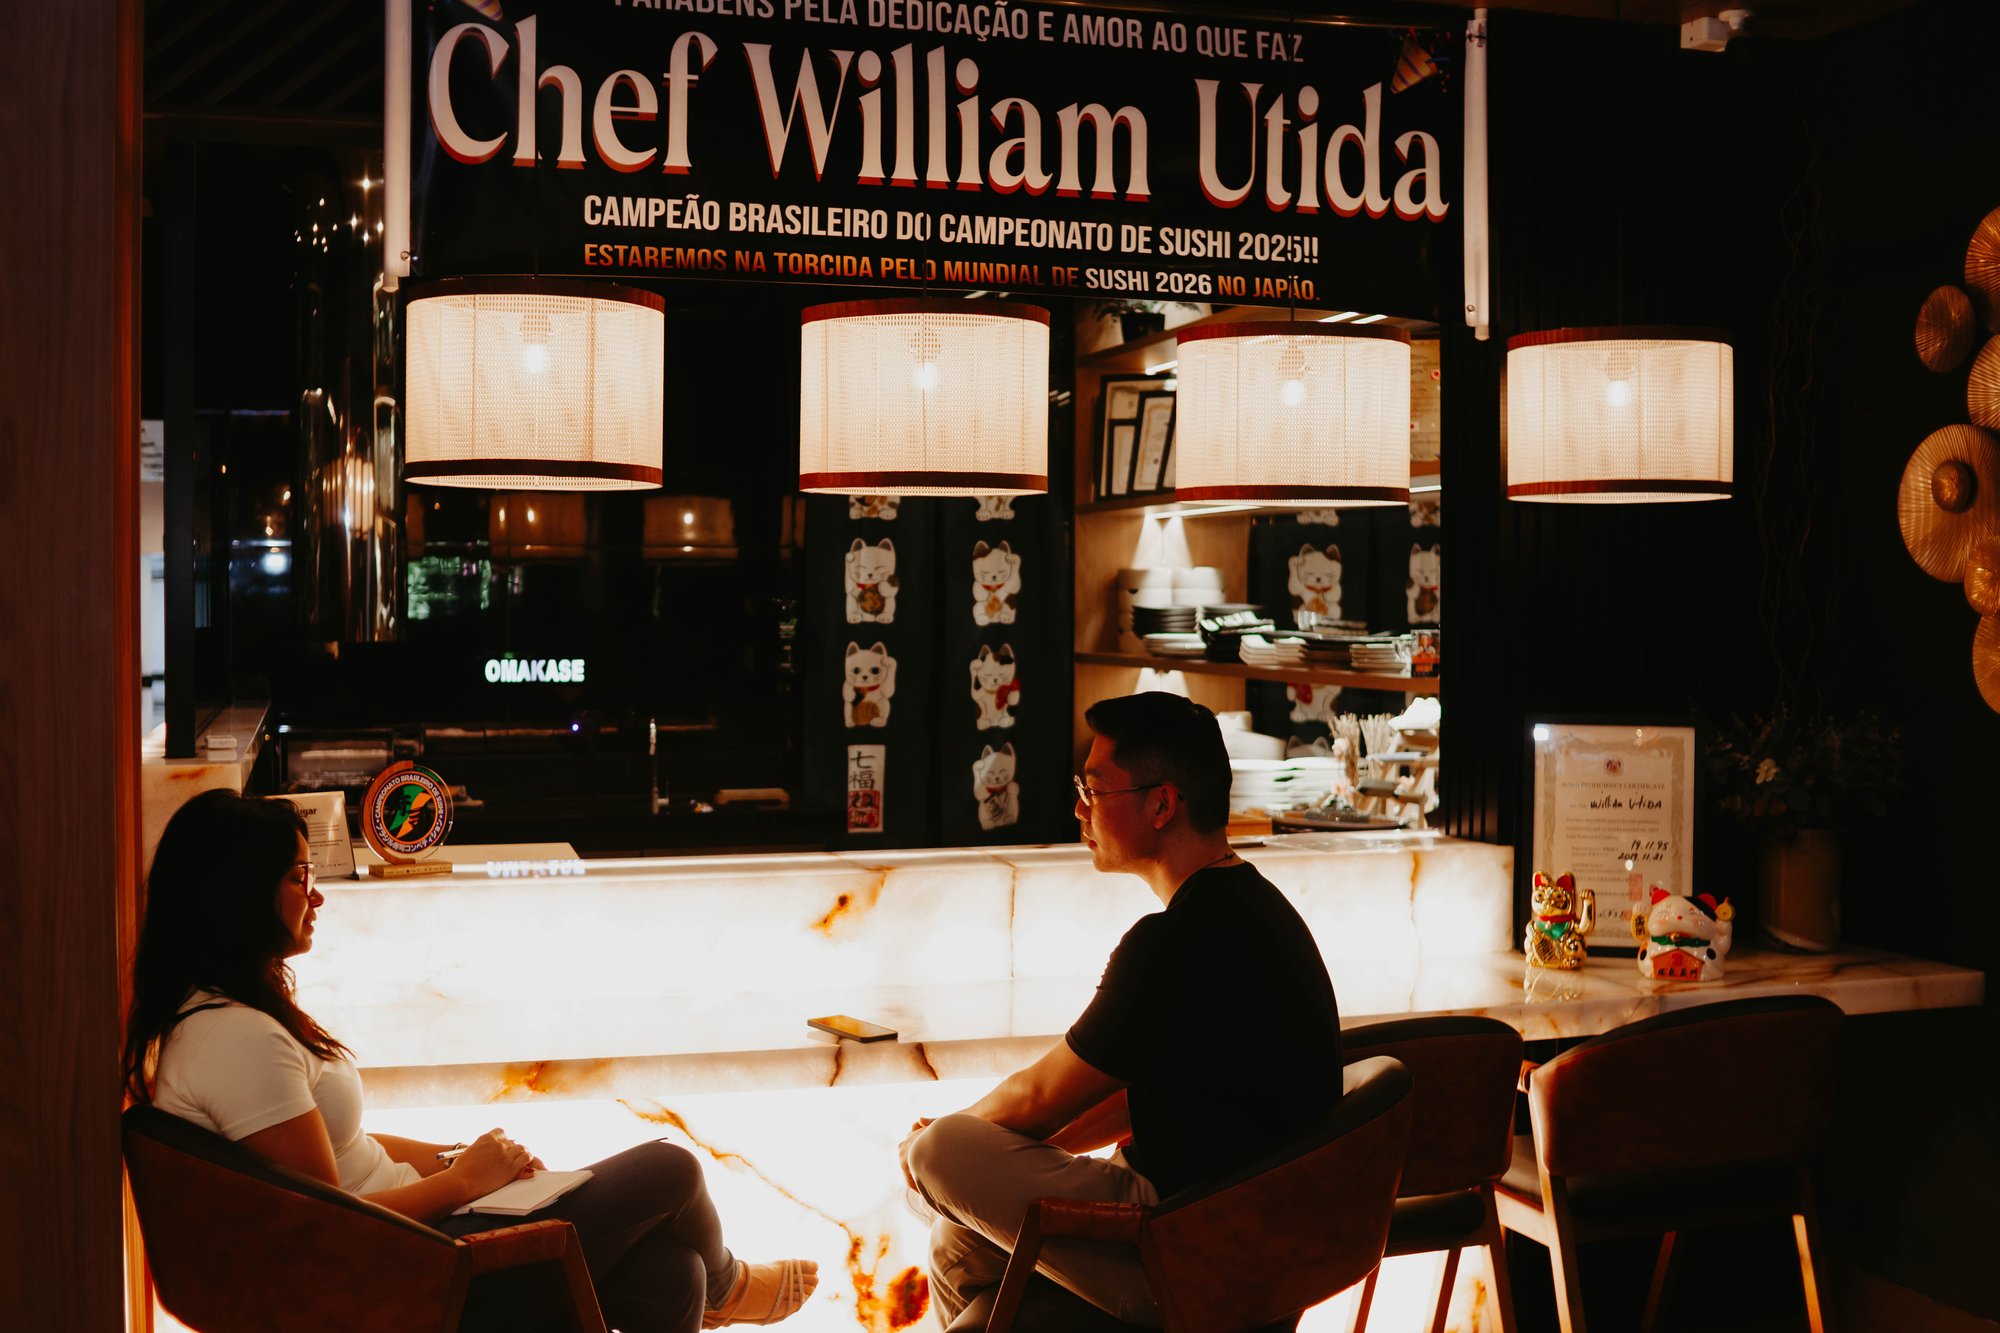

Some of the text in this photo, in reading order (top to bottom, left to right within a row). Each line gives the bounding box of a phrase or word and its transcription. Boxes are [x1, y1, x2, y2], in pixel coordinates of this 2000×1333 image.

[784, 0, 859, 25] PELA
[868, 0, 1029, 42] DEDICAÇÃO
[1038, 10, 1054, 42] E
[1062, 13, 1143, 49] AMOR
[1152, 21, 1187, 53] AO
[1196, 25, 1248, 58] QUE
[1256, 31, 1304, 63] FAZ
[428, 14, 1449, 223] Chef William Utida
[583, 193, 1319, 264] CAMPEÃO BRASILEIRO DO CAMPEONATO DE SUSHI 2025!!
[584, 243, 1321, 301] ESTAREMOS NA TORCIDA PELO MUNDIAL DE SUSHI 2026 NO JAPÃO.
[485, 659, 585, 682] OMAKASE
[375, 777, 401, 819] CAMPEONATO
